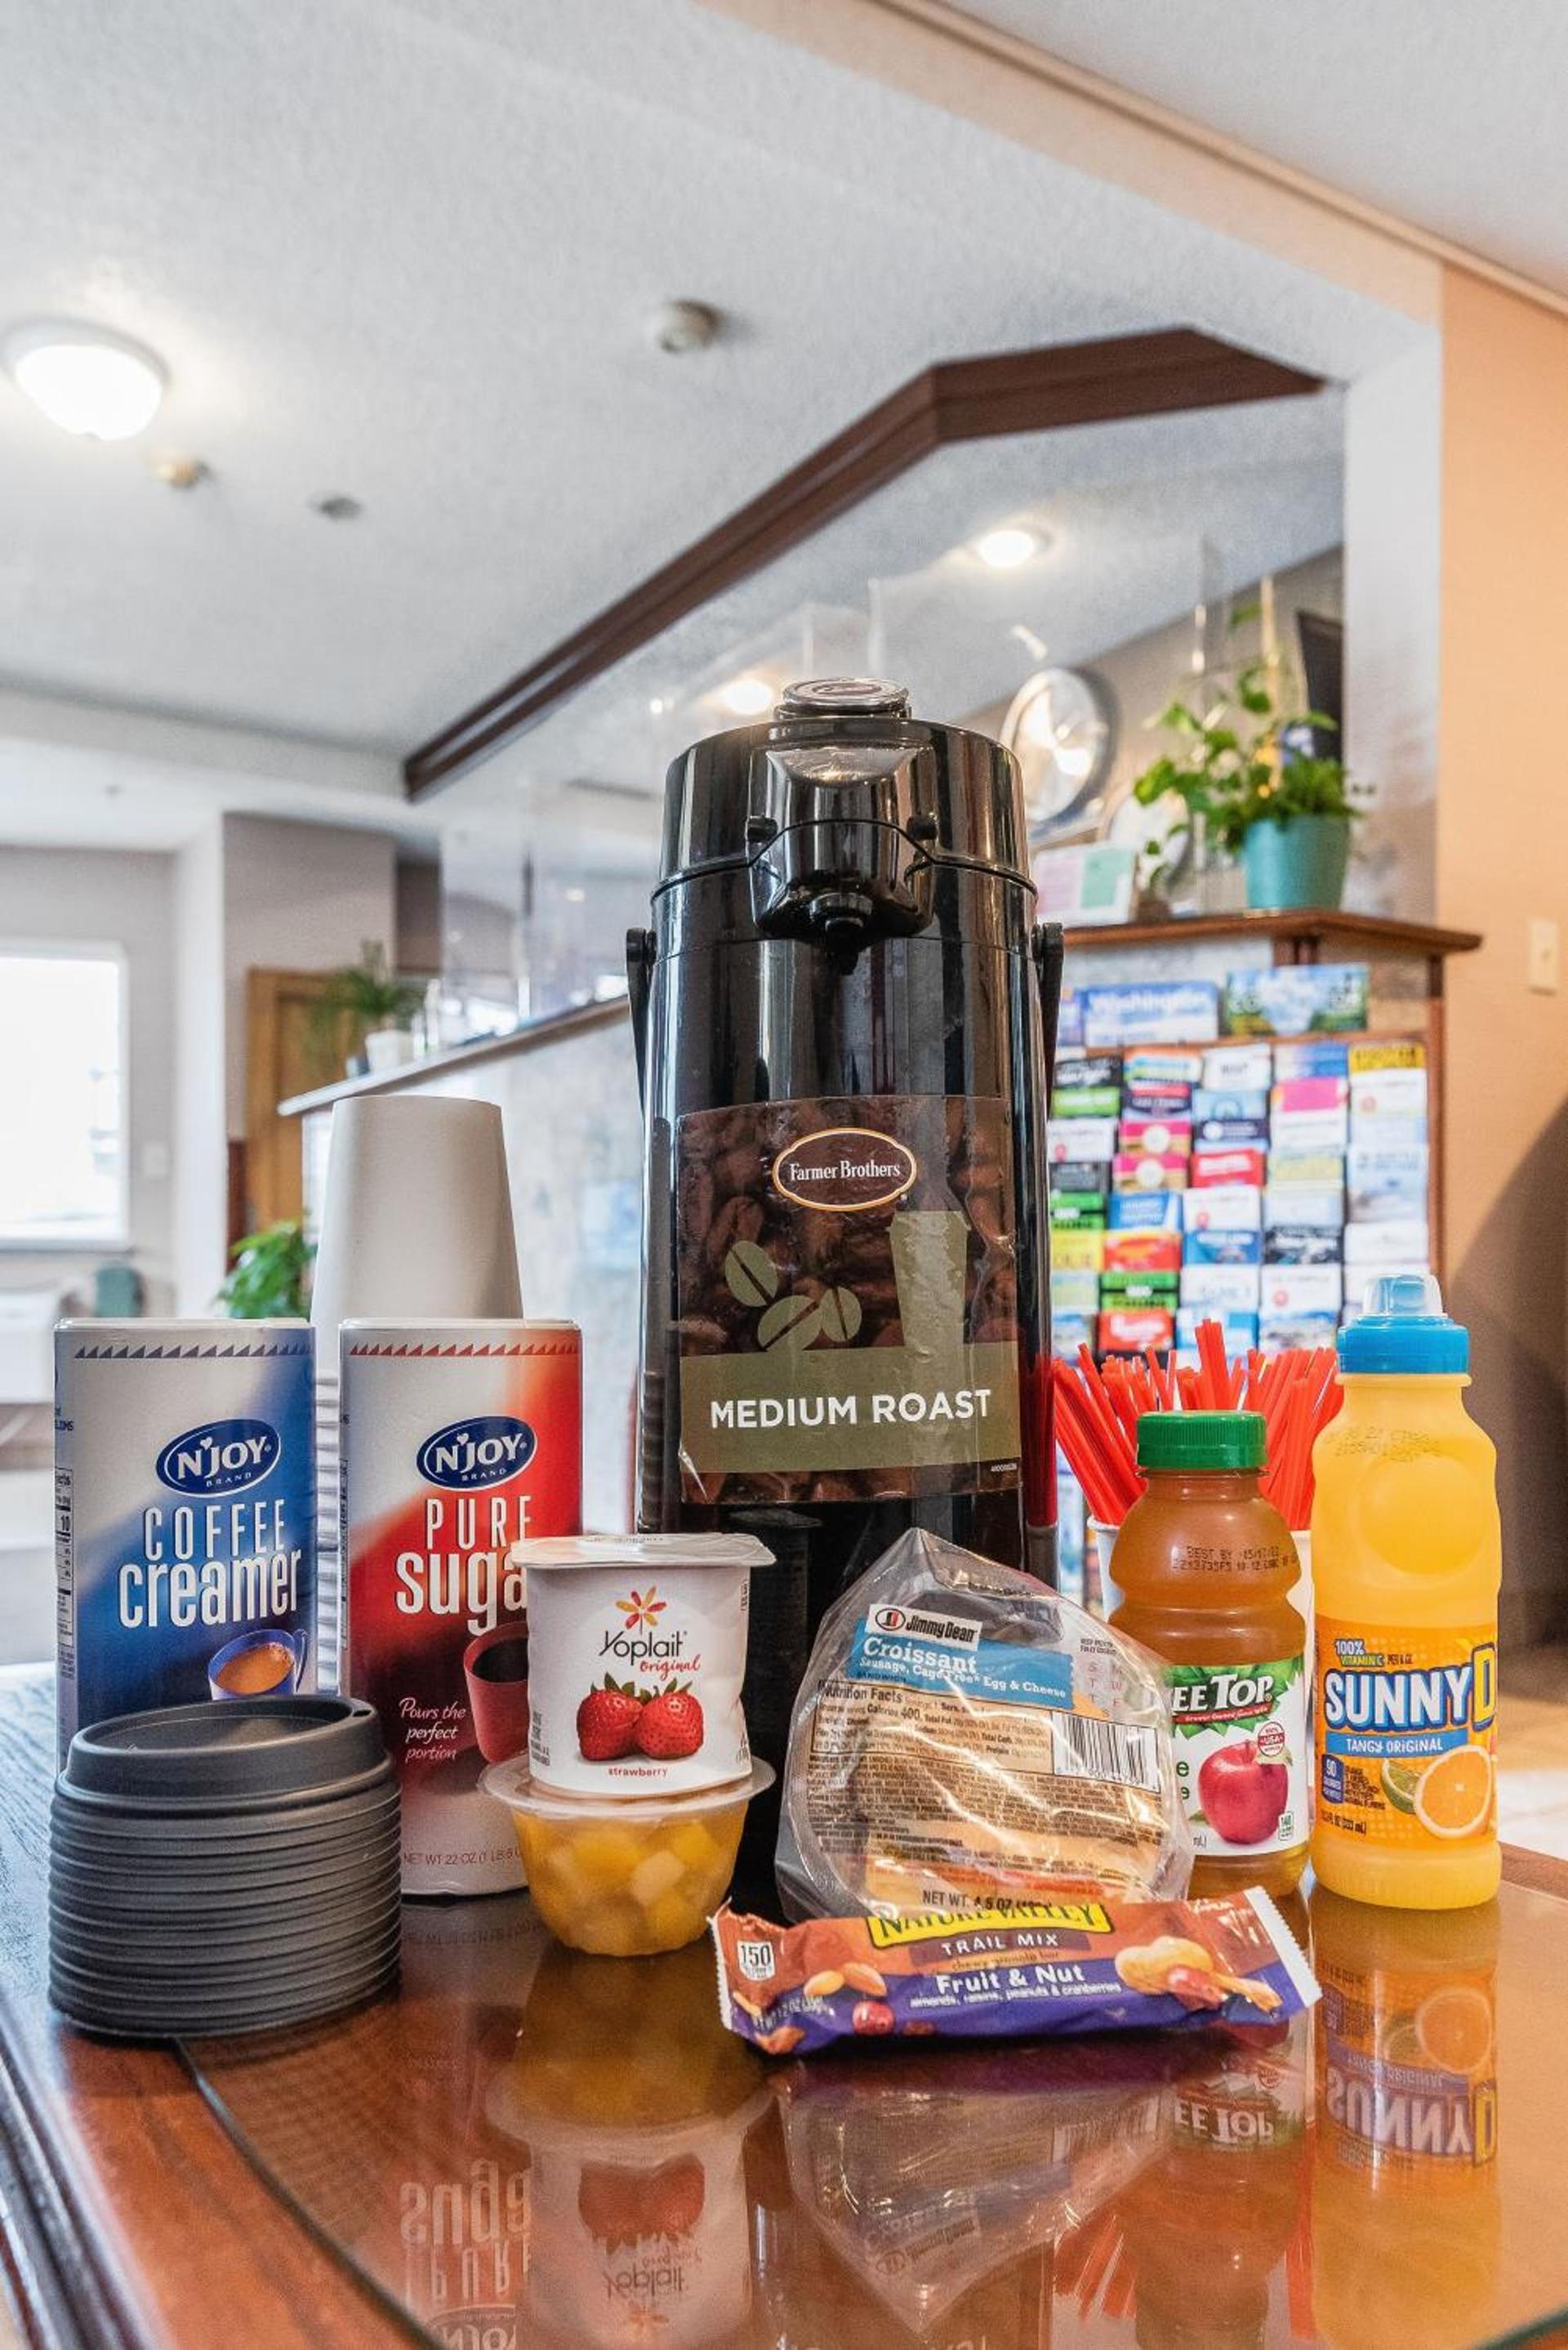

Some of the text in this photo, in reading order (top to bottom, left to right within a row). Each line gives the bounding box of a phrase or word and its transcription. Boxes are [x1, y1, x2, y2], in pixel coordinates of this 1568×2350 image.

[790, 1159, 901, 1181] Farmer Brothers
[710, 1389, 991, 1429] MEDIUM ROAST
[206, 1471, 252, 1488] BRAND
[461, 1467, 507, 1482] BRAND
[145, 1499, 284, 1561] COFFEE
[426, 1496, 531, 1550] PURE
[120, 1550, 301, 1628] creamer
[396, 1551, 528, 1637] suga
[906, 1615, 974, 1643] Jimmy Dean
[599, 1630, 683, 1666] Yoplait
[863, 1636, 977, 1674] Croissant
[1335, 1640, 1365, 1655] 100%
[639, 1654, 701, 1681] original
[859, 1657, 910, 1674] Sausage,
[983, 1675, 1007, 1692] Egg
[1009, 1680, 1019, 1691] &
[1022, 1681, 1066, 1698] Cheese
[399, 1697, 467, 1719] Pours the
[871, 1687, 902, 1704] Facts
[1171, 1686, 1209, 1711] EE
[405, 1720, 458, 1745] perfect
[405, 1745, 457, 1764] portion
[1346, 1737, 1443, 1754] TANGY ORIGINAL
[608, 1767, 668, 1779] strawberry
[923, 1889, 945, 1906] NET
[740, 1944, 771, 1966] 150
[942, 1932, 1059, 1956] TRAIL MIX
[936, 1964, 1085, 1995] Fruit & Nut
